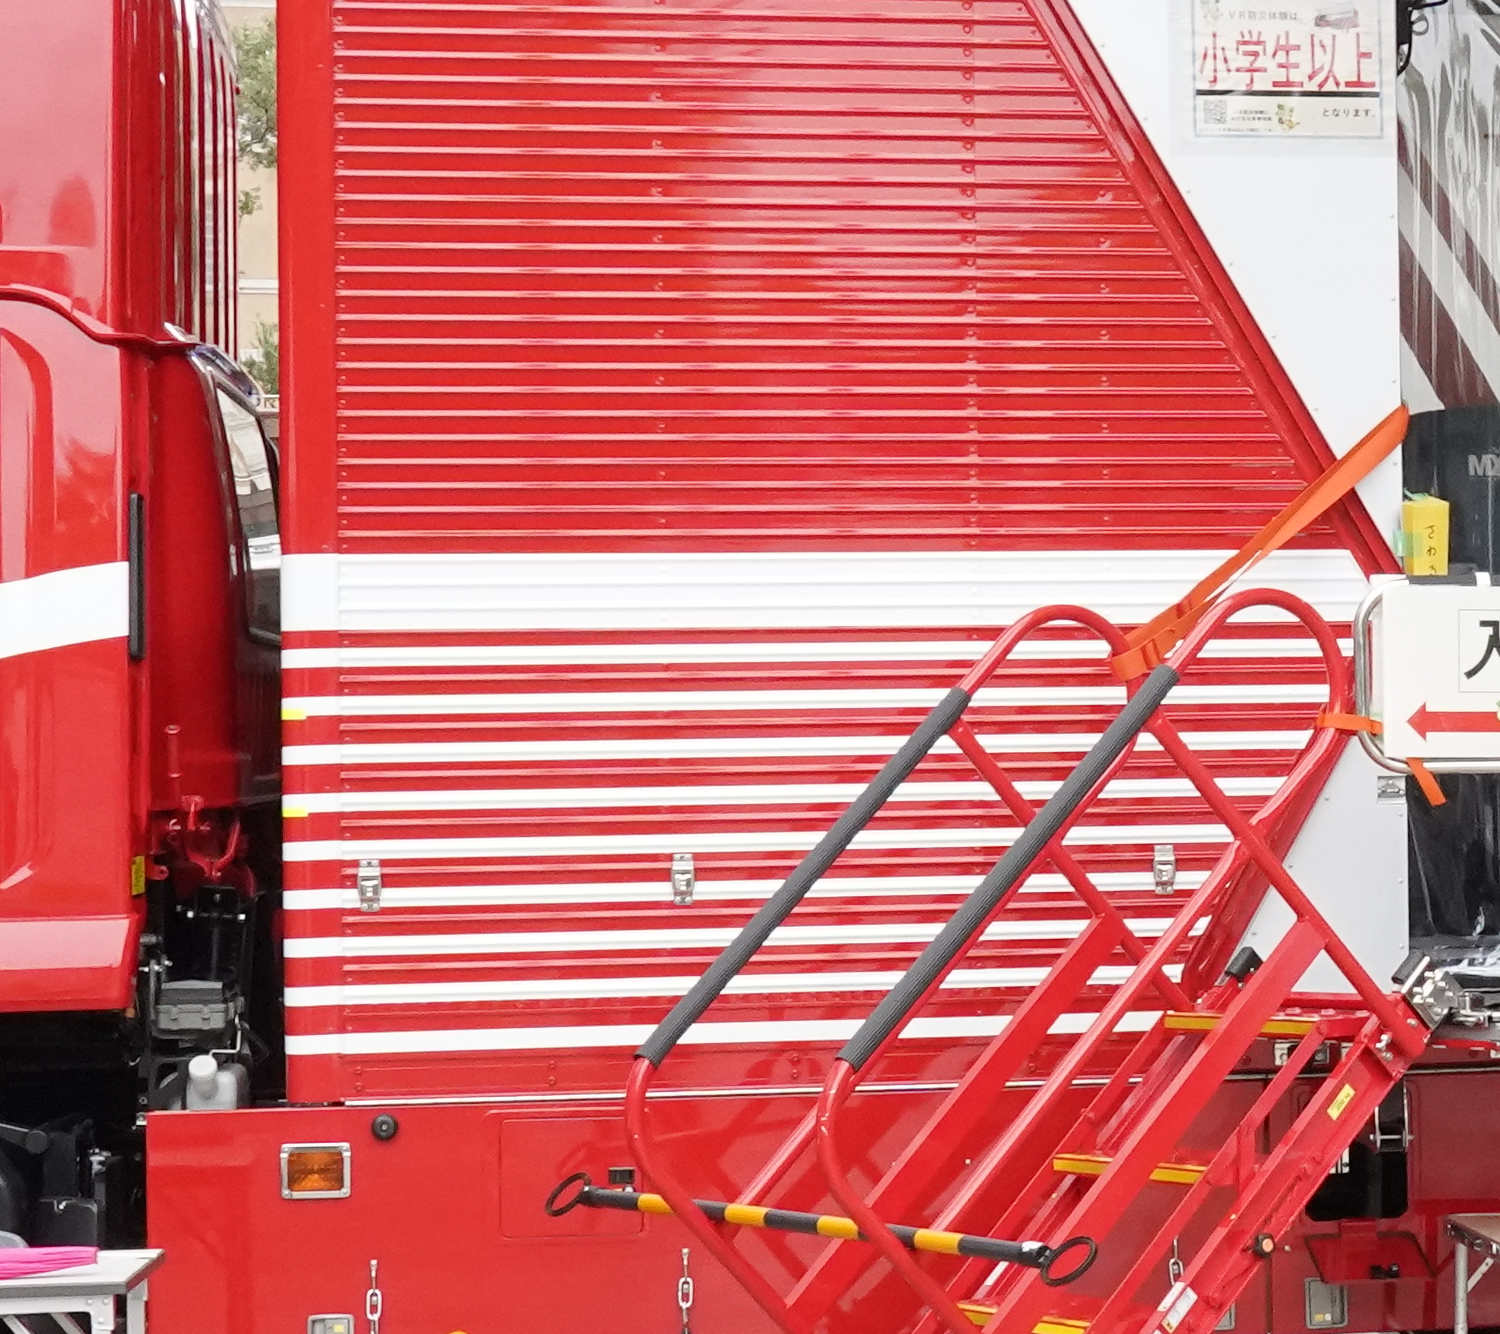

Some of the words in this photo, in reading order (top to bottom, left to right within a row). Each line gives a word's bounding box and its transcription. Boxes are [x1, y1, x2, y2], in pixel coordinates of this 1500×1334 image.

[1199, 30, 1377, 92] 小学生以上
